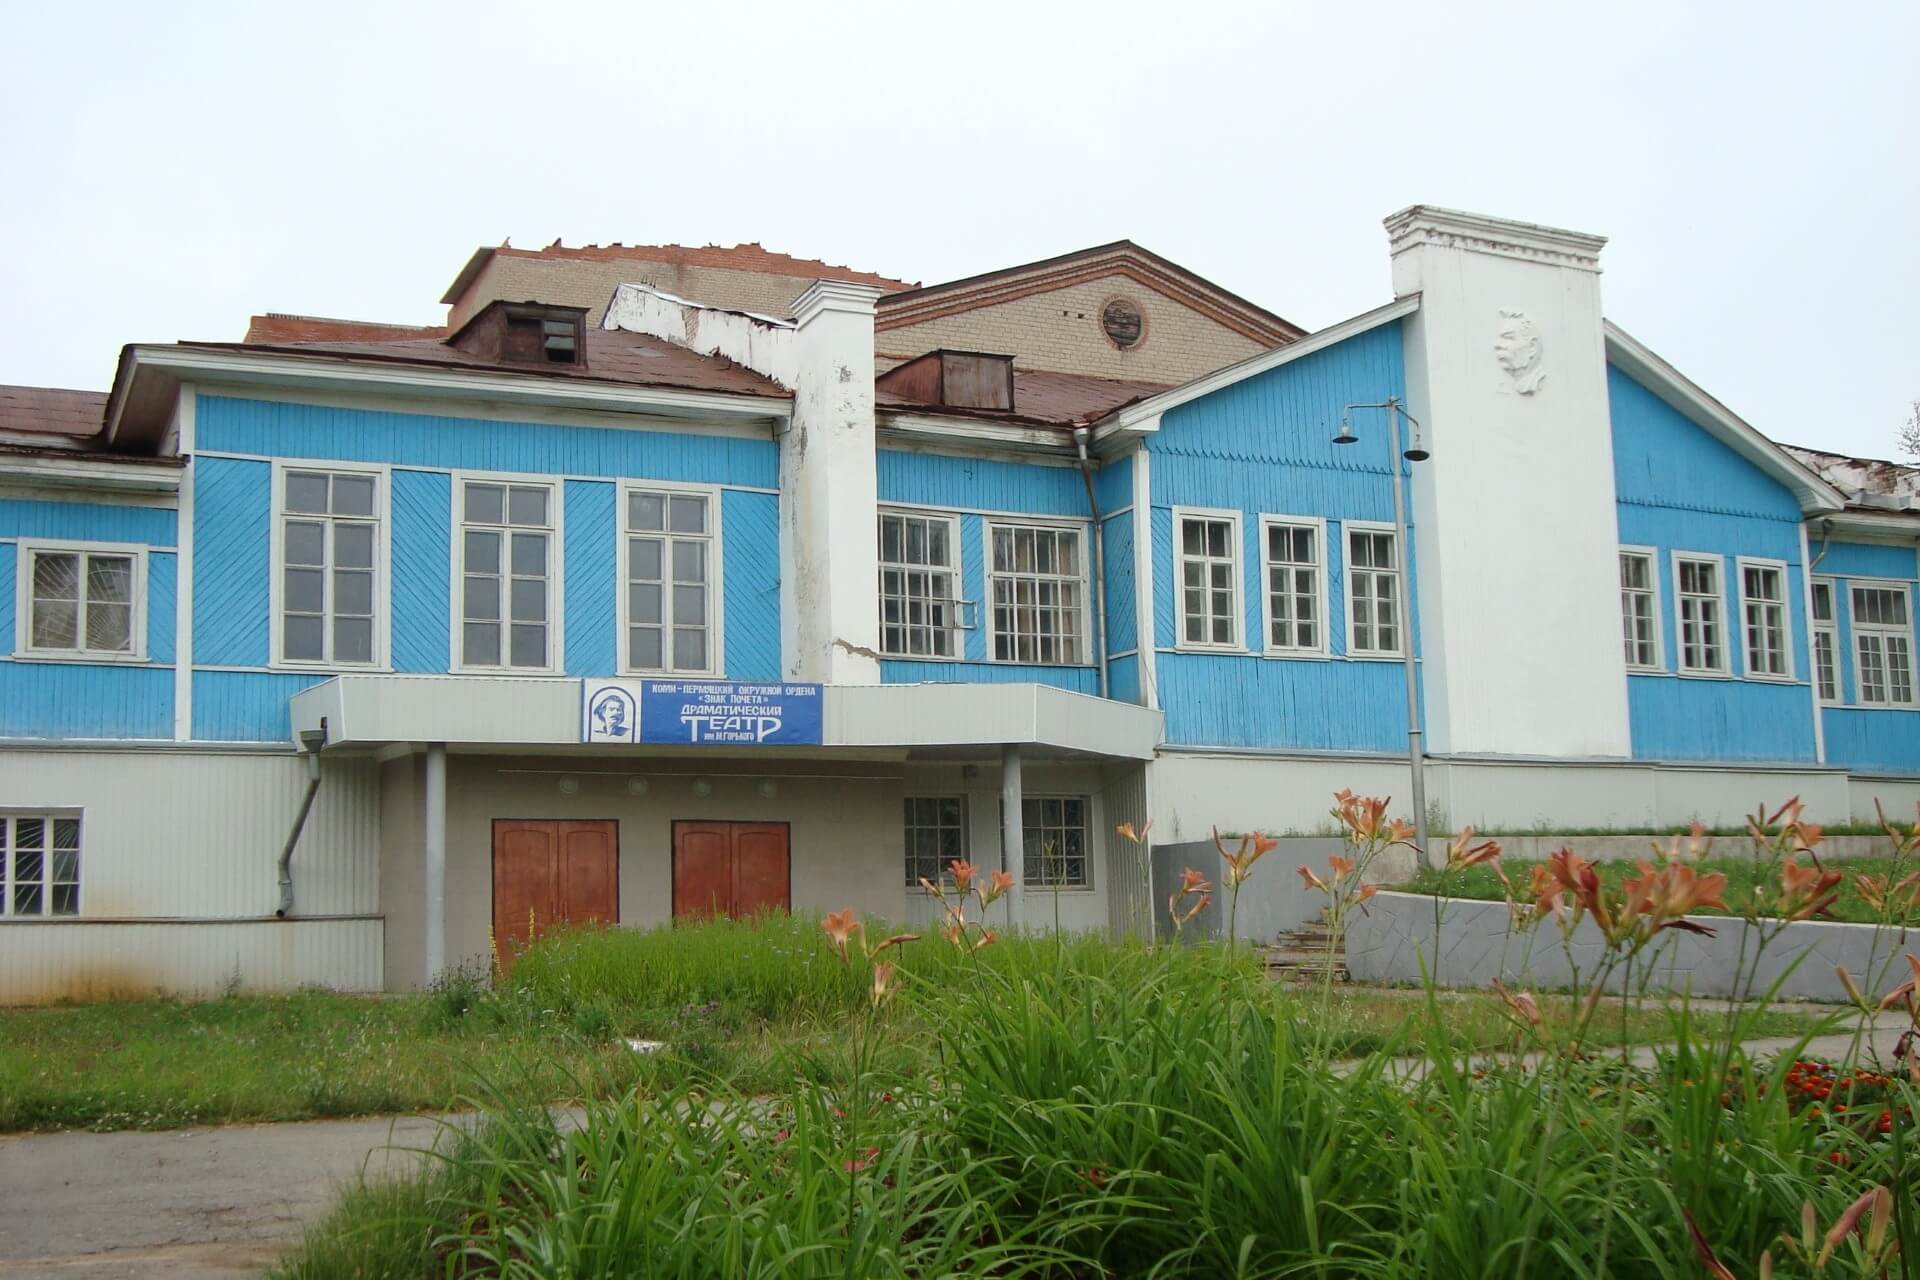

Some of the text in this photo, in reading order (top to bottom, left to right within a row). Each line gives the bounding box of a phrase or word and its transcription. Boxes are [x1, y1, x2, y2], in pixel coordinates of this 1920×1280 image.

[738, 685, 782, 695] ОКРУЖНОЙ
[785, 686, 816, 696] ОРДЕНА
[680, 704, 782, 716] ДРАМАТИЧЕСКИЙ
[680, 715, 782, 742] ТЕАТР
